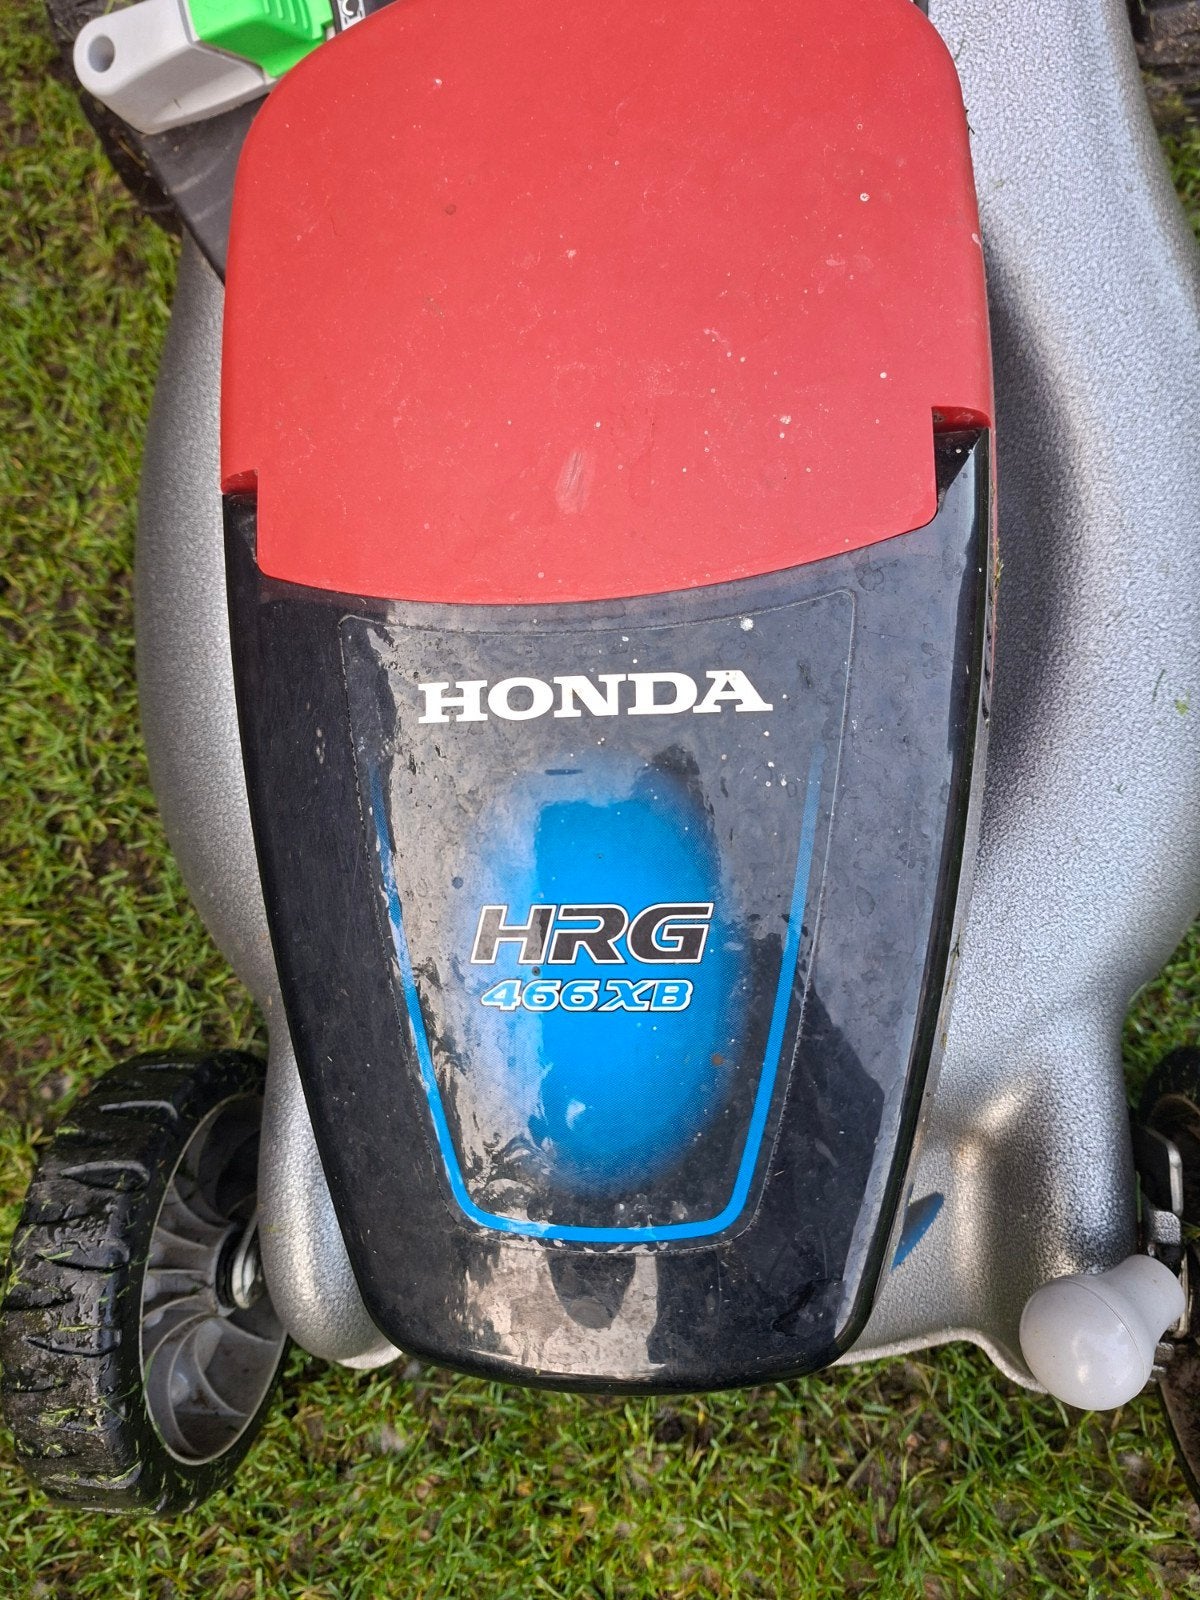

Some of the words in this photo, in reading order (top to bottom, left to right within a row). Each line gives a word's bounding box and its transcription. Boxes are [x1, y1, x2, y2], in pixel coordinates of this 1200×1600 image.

[418, 670, 774, 724] HONDA
[470, 902, 715, 965] HRG
[481, 978, 694, 1012] 466XB
